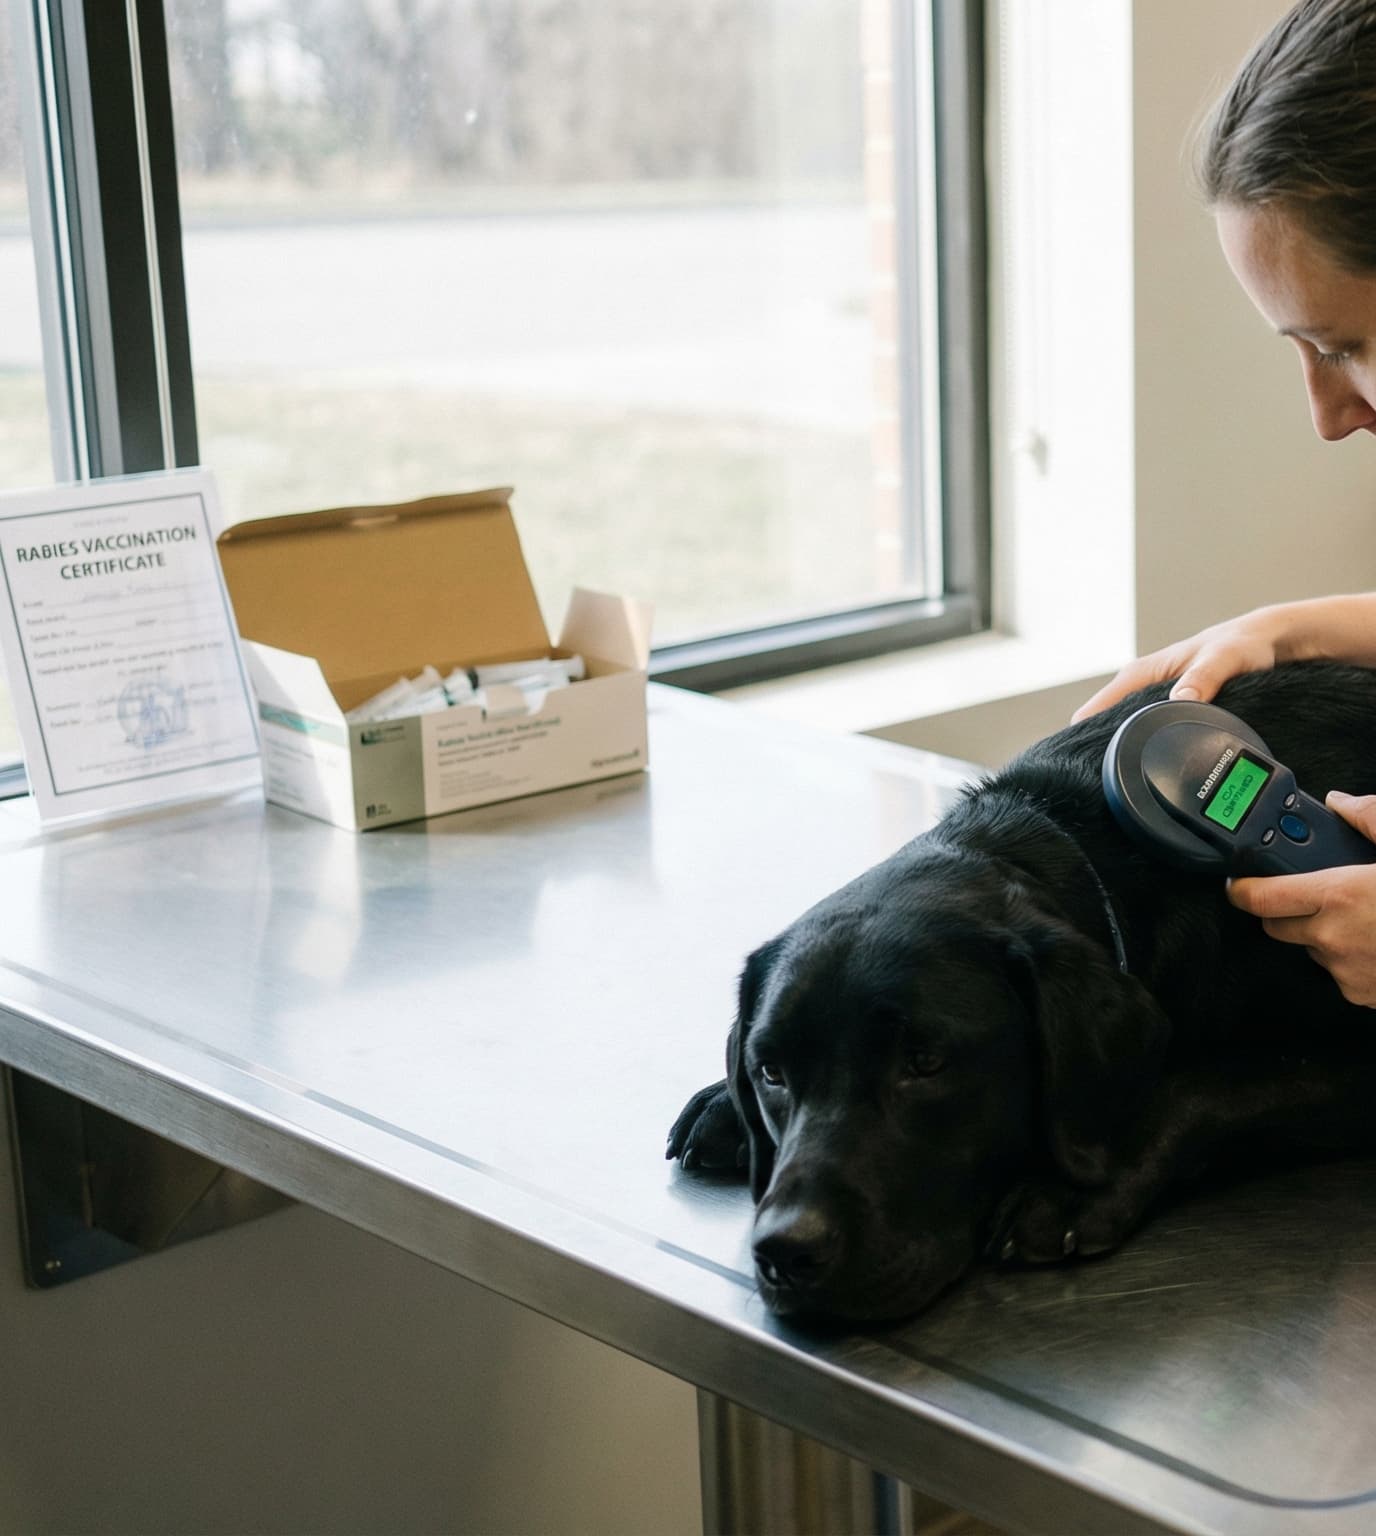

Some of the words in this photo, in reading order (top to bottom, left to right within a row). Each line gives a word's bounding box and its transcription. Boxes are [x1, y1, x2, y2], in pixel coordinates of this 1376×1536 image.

[16, 541, 79, 562] RABIES
[82, 526, 196, 553] VACCINATION
[60, 552, 166, 580] CERTIFICATE
